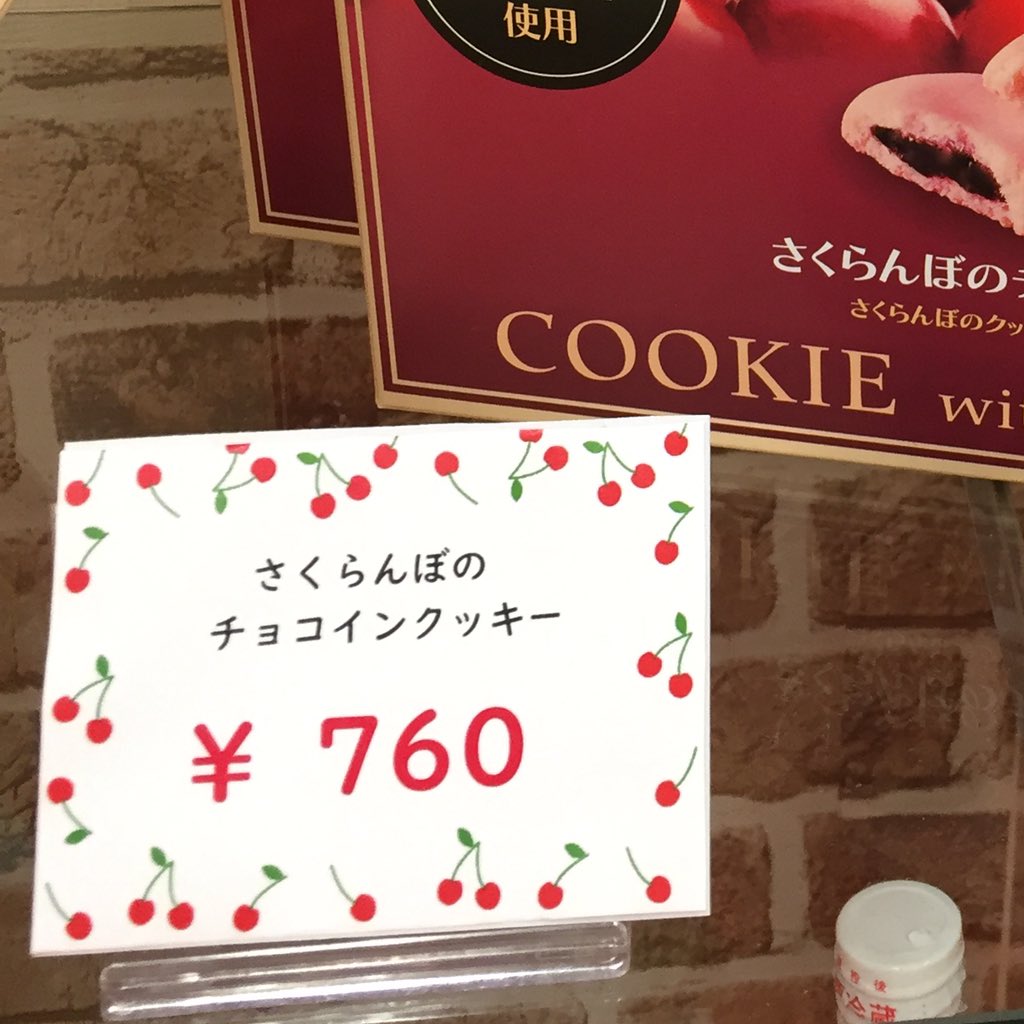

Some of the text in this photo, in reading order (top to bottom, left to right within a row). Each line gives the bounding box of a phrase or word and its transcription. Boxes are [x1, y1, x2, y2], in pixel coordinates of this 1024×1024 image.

[503, 1, 578, 44] 使用
[496, 310, 897, 416] COOKIE
[255, 547, 486, 592] さくらんぼの
[210, 602, 560, 651] チョコインクッキー
